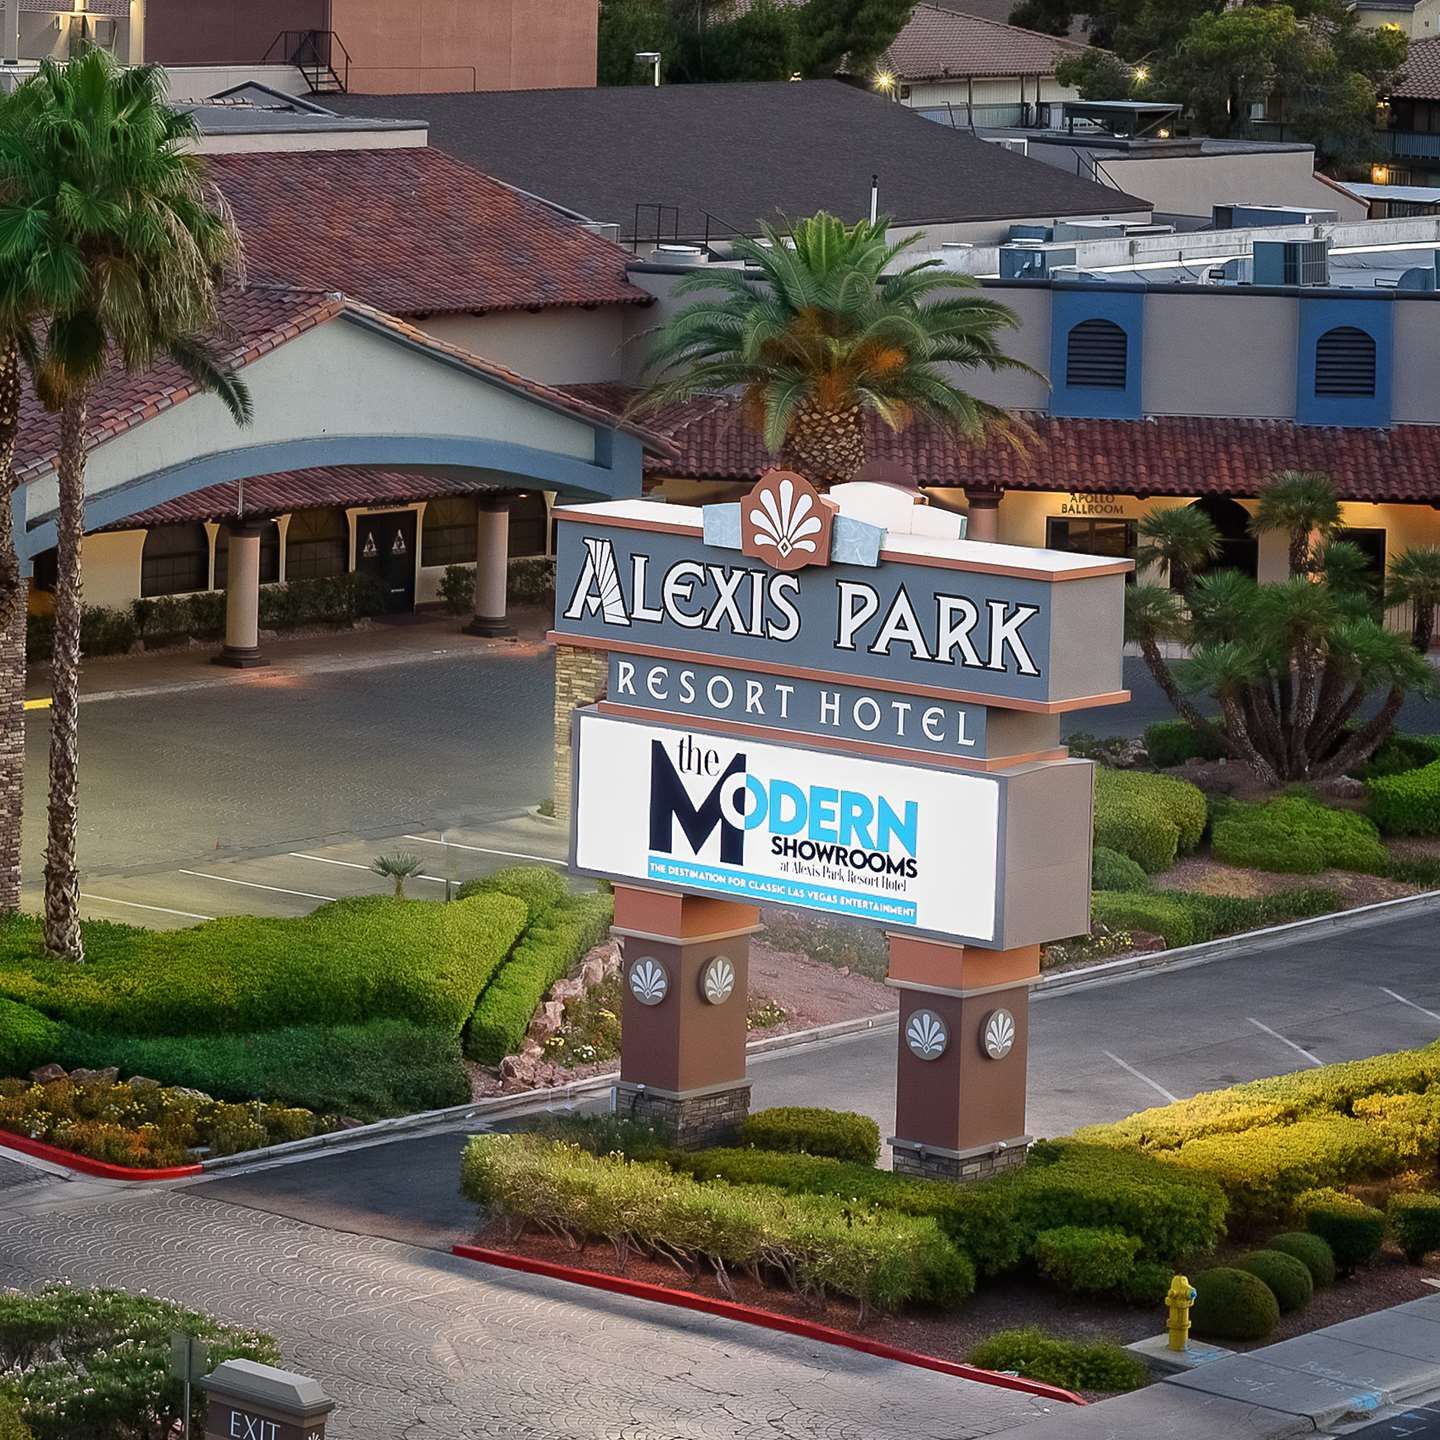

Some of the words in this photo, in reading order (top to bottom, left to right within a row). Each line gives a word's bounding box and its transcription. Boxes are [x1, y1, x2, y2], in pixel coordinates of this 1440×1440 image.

[1061, 503, 1124, 514] BALLROOM
[1070, 493, 1115, 504] APOLLO
[563, 537, 801, 642] ALEXIS
[834, 579, 1041, 677] PARK
[617, 661, 795, 719] RESORT
[819, 691, 976, 747] HOTEL
[677, 735, 721, 777] the
[648, 739, 919, 866] MODERN
[771, 836, 918, 879] SHOWROOMS
[780, 862, 789, 872] at
[792, 861, 821, 877] Alexis
[822, 864, 845, 882] Park
[847, 870, 879, 889] Resort
[881, 875, 907, 892] Hotel
[650, 863, 666, 873] THE
[668, 865, 727, 884] DESTINATION
[728, 878, 747, 887] FOR
[748, 880, 786, 895] CLASSIC
[788, 887, 805, 898] LAS
[807, 891, 839, 904] VEGAS
[840, 896, 916, 918] ENTERTAINMENT
[230, 1410, 281, 1440] EXIT
